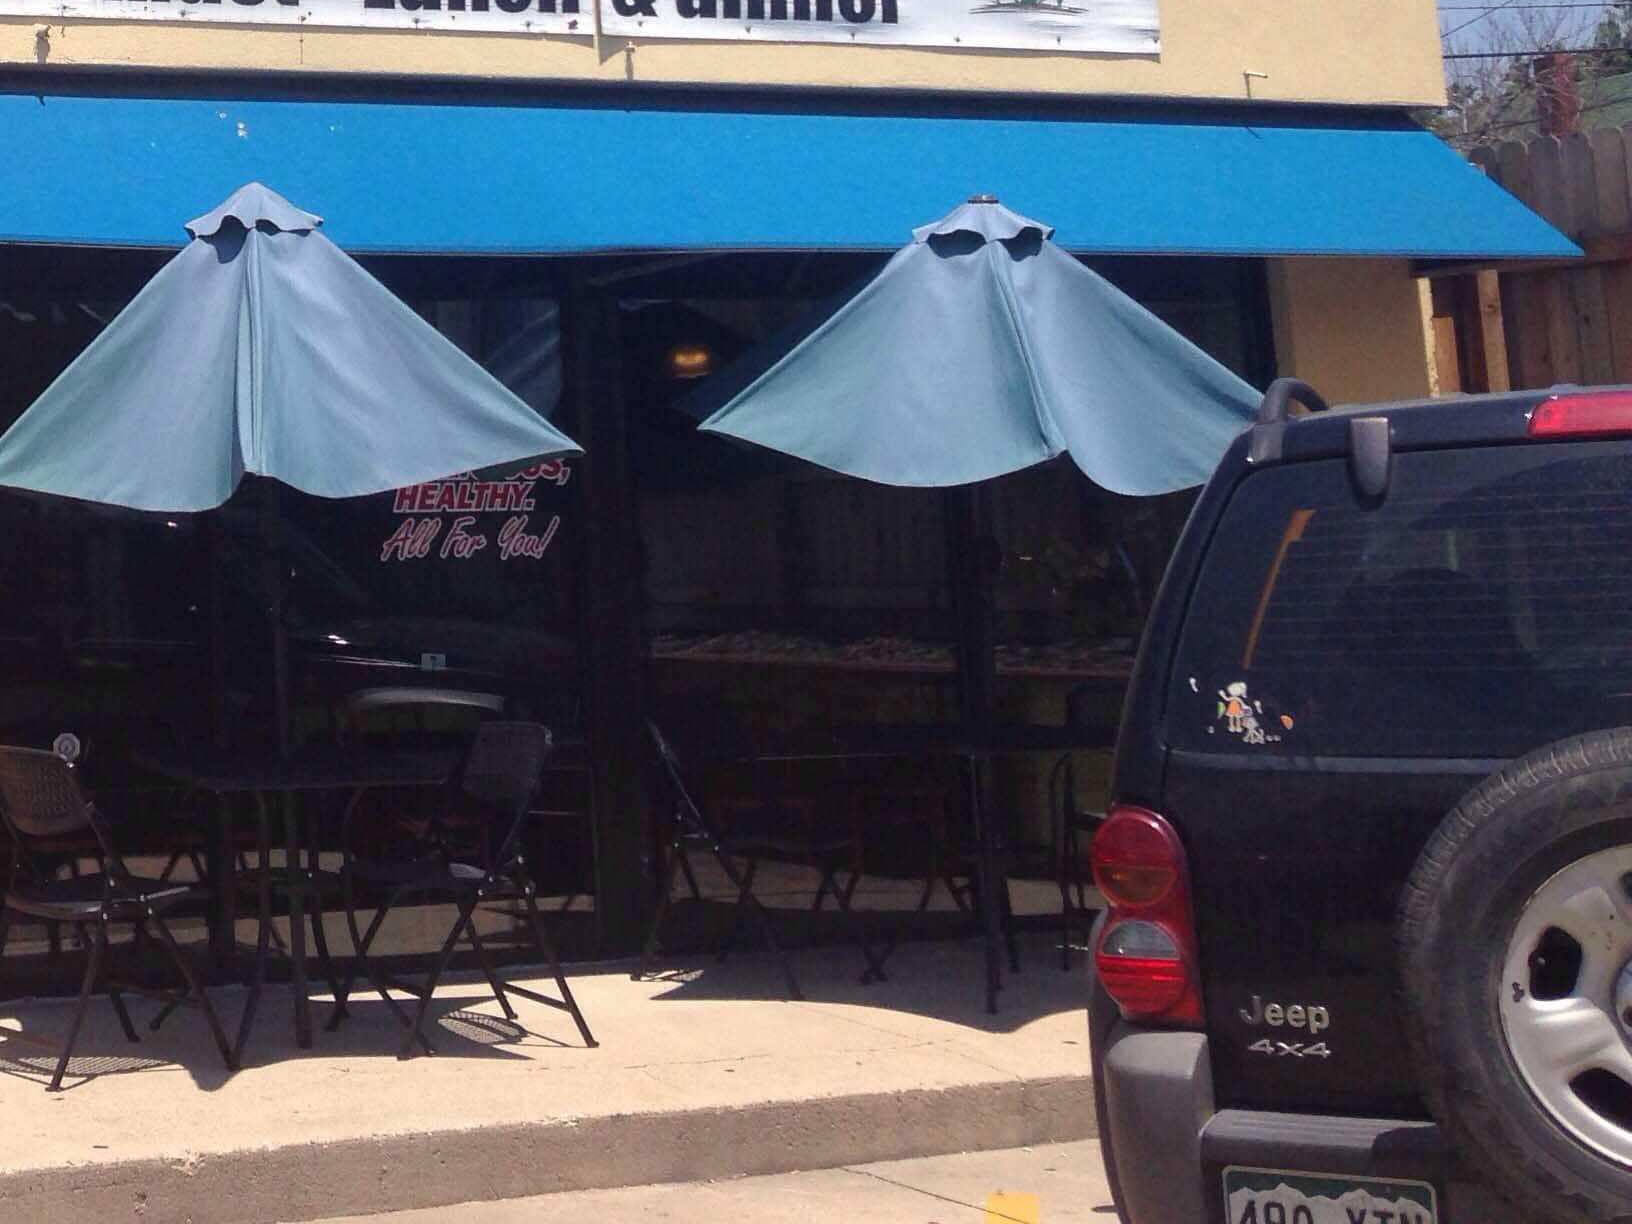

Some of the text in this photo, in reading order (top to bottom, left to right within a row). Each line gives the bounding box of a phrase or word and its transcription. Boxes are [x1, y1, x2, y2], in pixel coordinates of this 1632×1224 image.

[393, 481, 536, 513] HEALTHY.
[381, 515, 560, 561] All For You!
[1239, 995, 1330, 1033] Jeep
